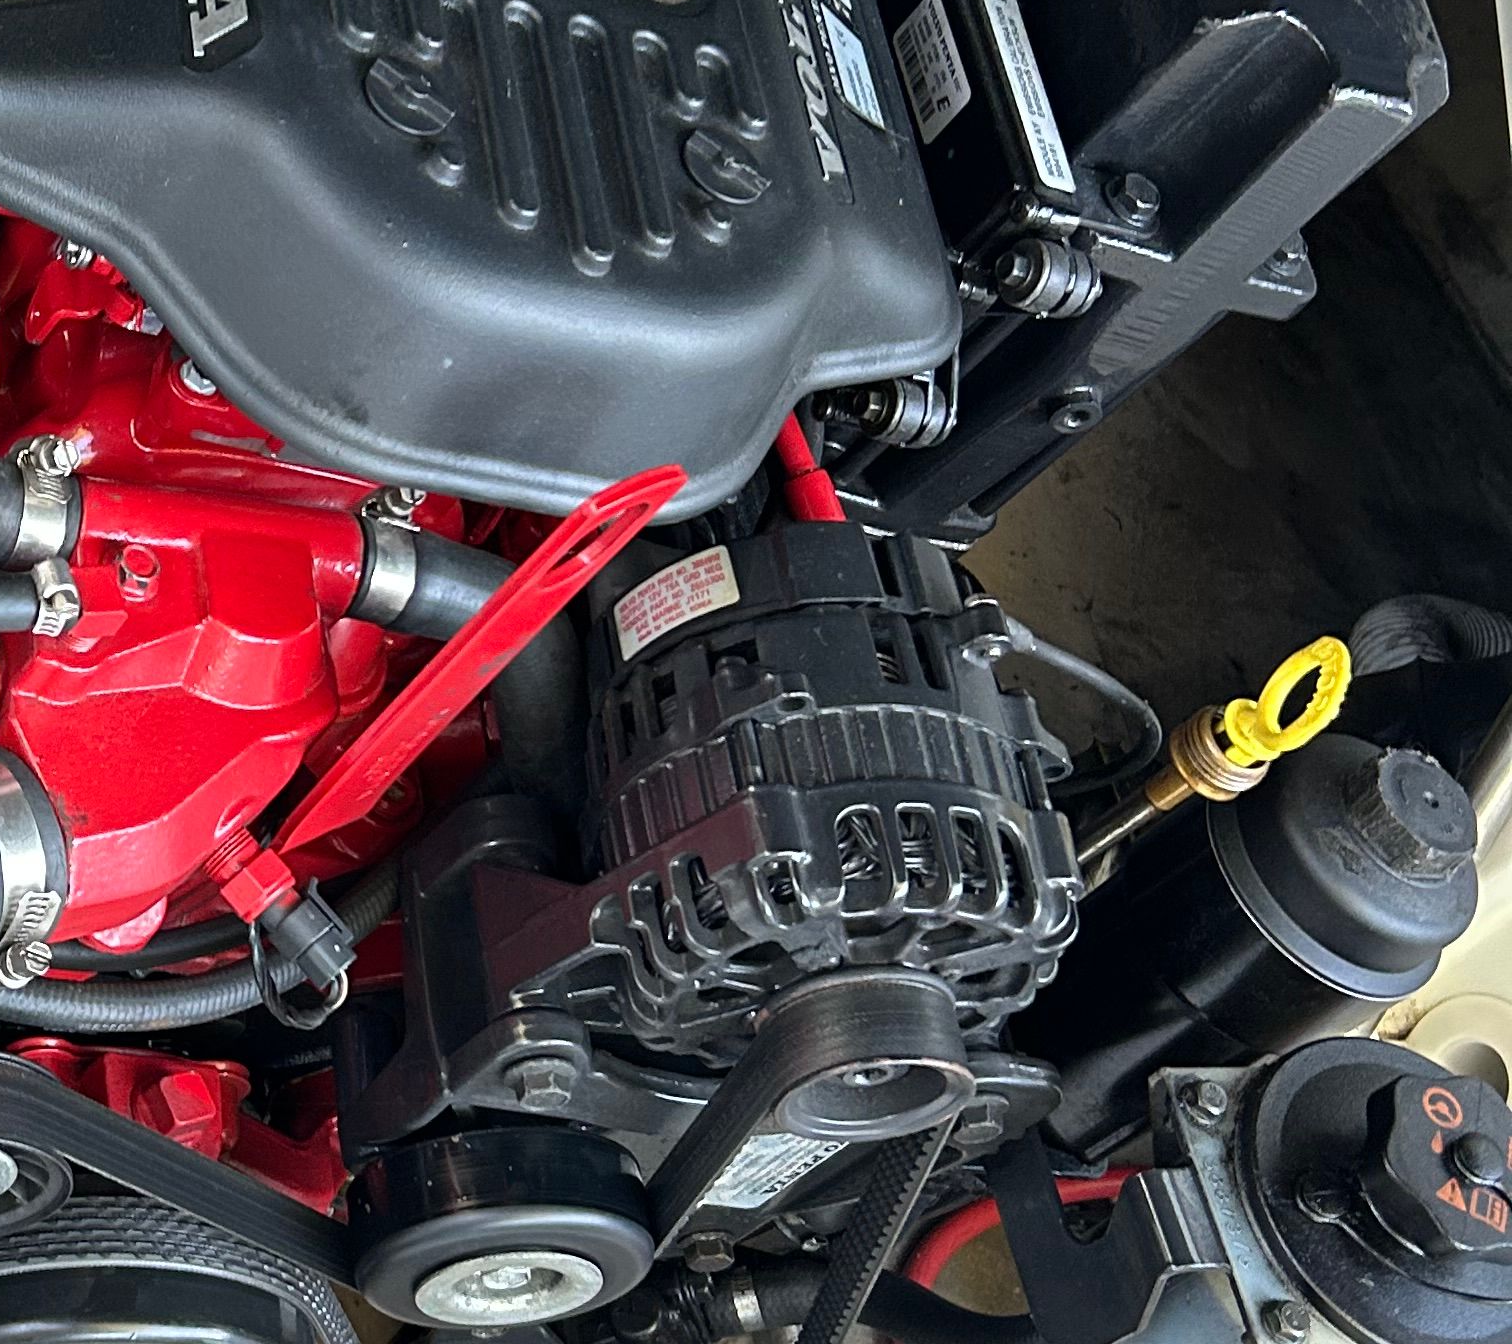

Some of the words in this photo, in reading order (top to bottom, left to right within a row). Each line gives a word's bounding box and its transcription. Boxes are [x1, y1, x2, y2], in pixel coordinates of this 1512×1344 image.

[929, 0, 943, 38] VOLVO
[940, 36, 956, 78] PENTA
[936, 96, 951, 112] E
[704, 562, 723, 574] NEG
[651, 601, 681, 622] MARINE
[761, 1154, 824, 1196] PENTA
